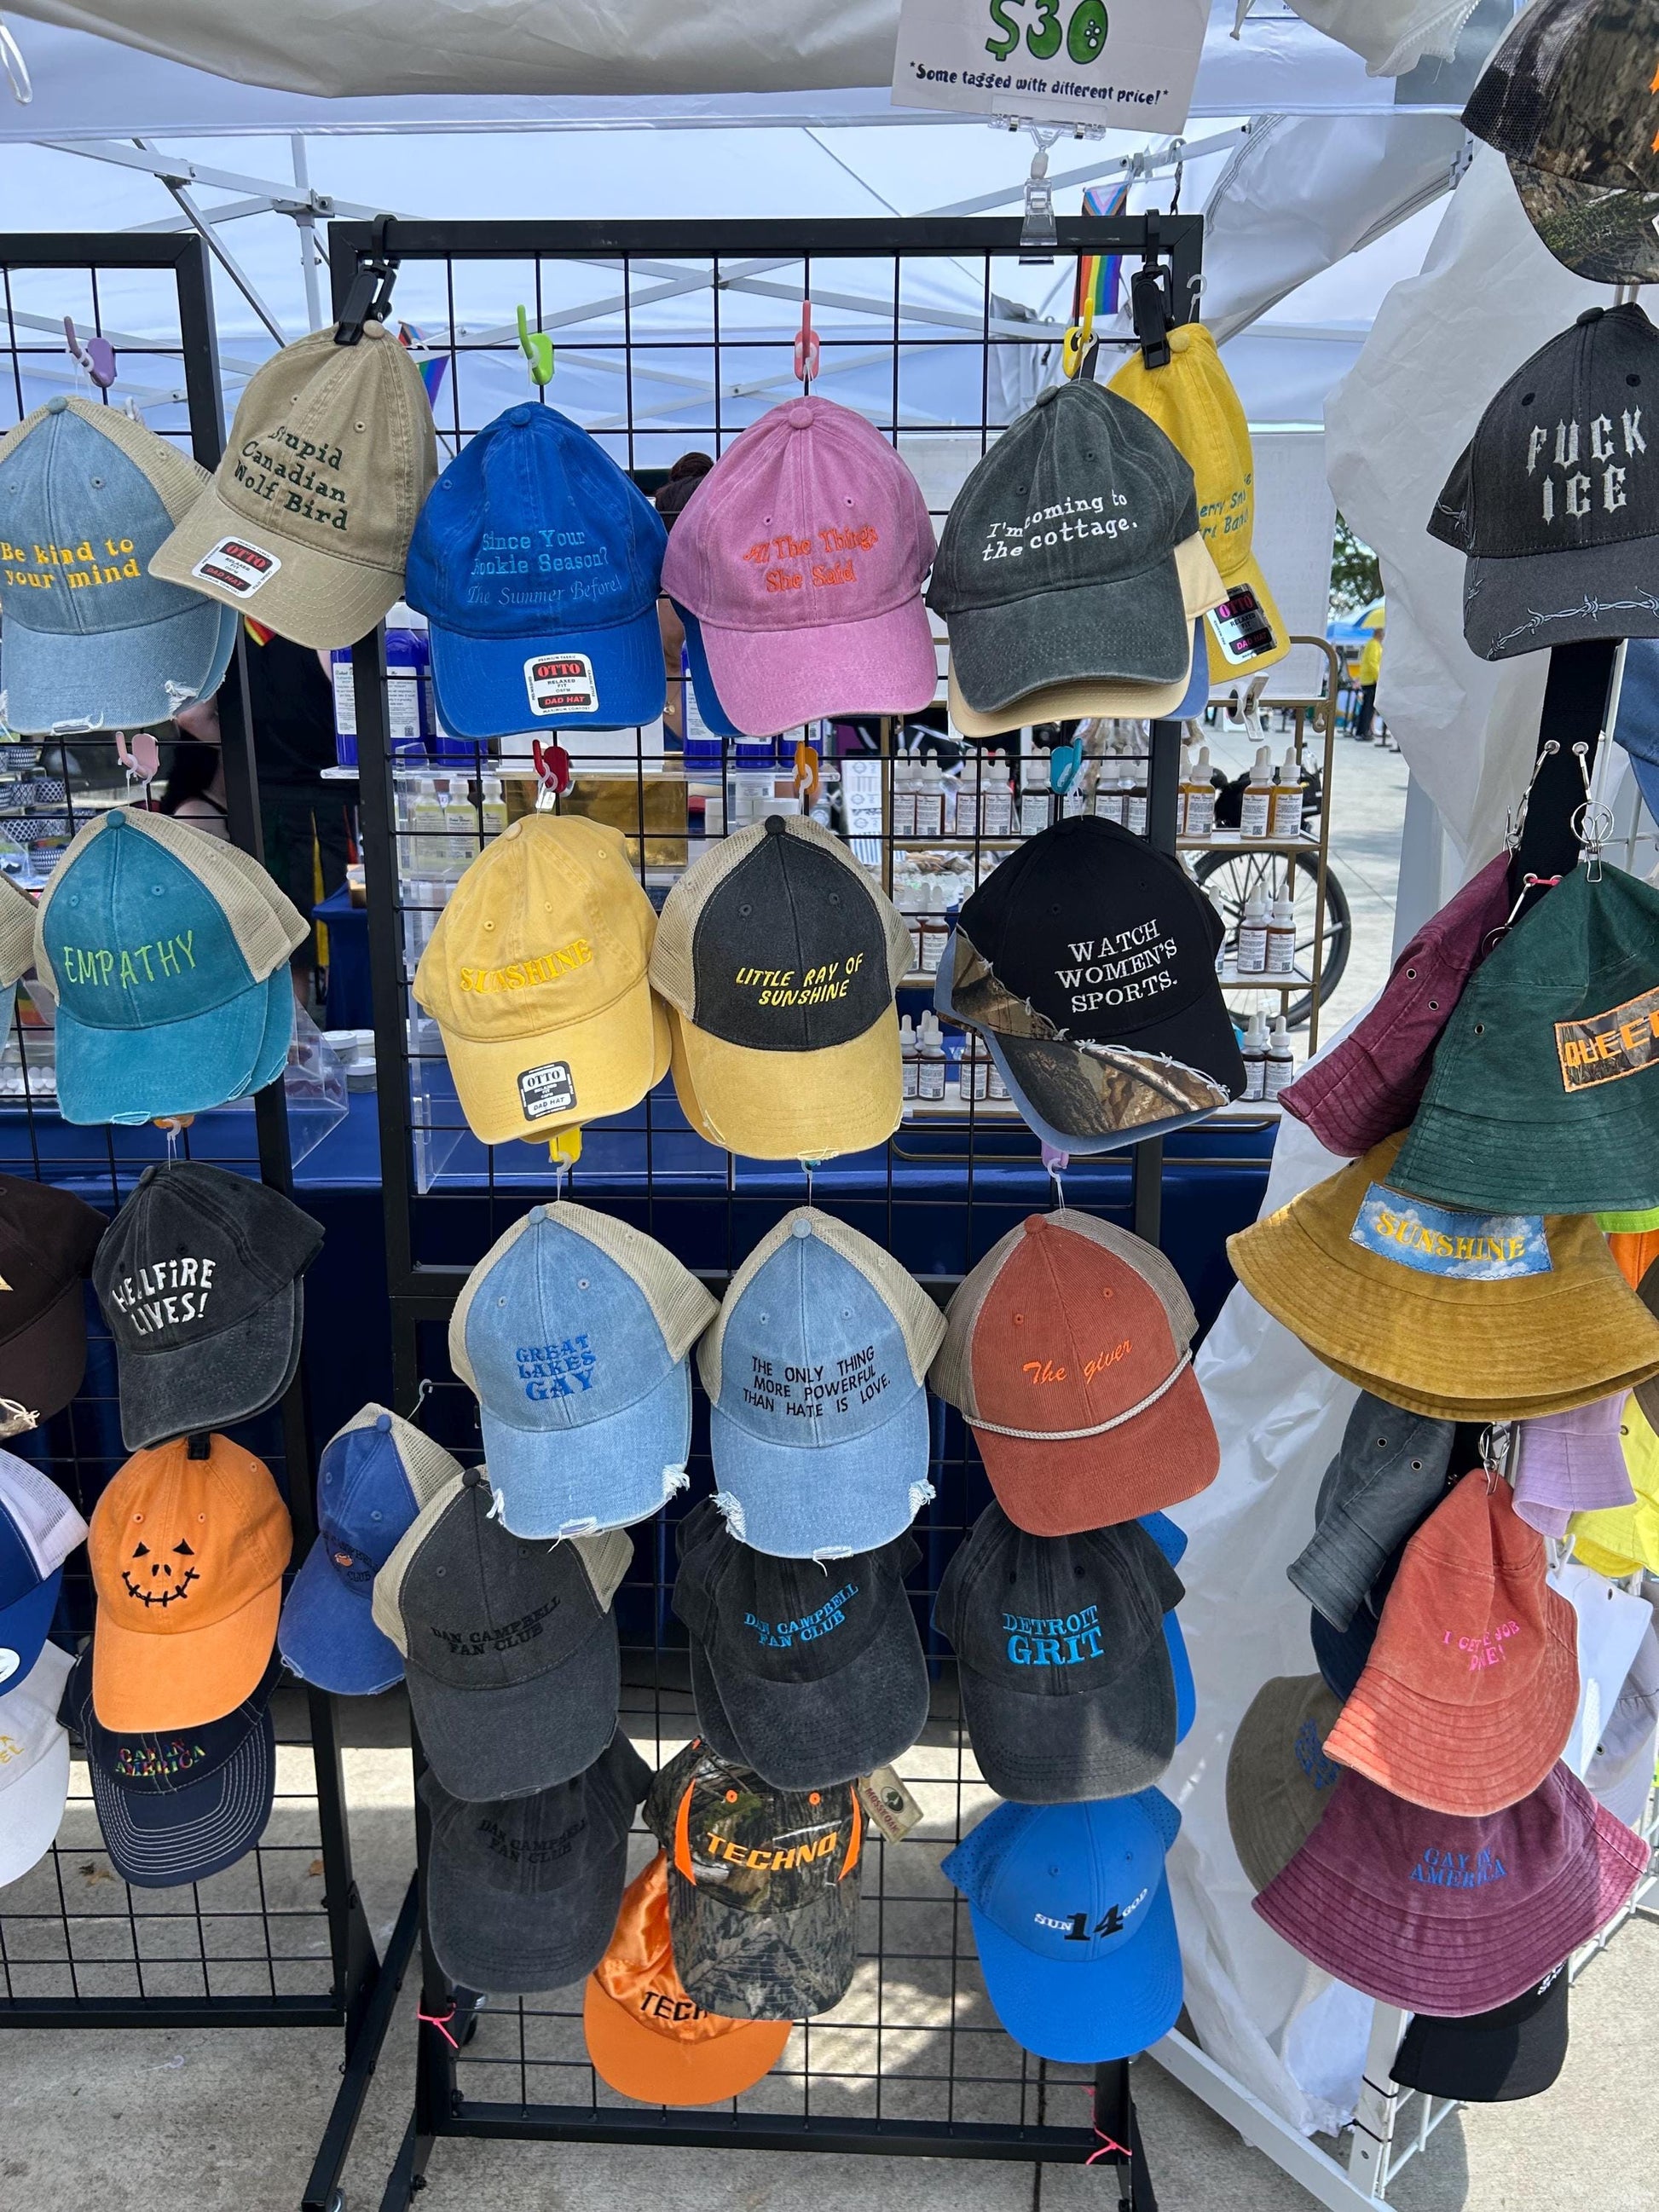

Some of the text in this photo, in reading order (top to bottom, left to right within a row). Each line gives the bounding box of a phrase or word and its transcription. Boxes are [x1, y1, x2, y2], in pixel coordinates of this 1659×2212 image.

[986, 0, 1108, 65] $30
[962, 69, 1011, 90] tagged
[1015, 77, 1047, 93] with
[1051, 80, 1113, 101] different
[268, 425, 343, 471] Stupid
[1526, 404, 1647, 477] FUCK
[242, 441, 347, 503] Canadian
[234, 459, 348, 531] Wolf Bird
[1542, 464, 1627, 526] ICE
[986, 488, 1127, 539] I'm coming to
[1, 538, 135, 565] Be kind to
[226, 545, 266, 568] OTTO
[483, 528, 586, 551] Since Your
[772, 535, 812, 559] The
[818, 524, 879, 552] Things
[982, 517, 1137, 561] the cottage.
[5, 558, 142, 589] your mind
[206, 567, 244, 586] DAD HAT
[539, 546, 609, 572] Season?
[766, 559, 857, 592] She Said
[466, 574, 622, 607] The Summer Before!
[1219, 595, 1253, 618] OTTO
[1230, 613, 1256, 627] RELAXED
[1236, 638, 1252, 650] DAD
[537, 663, 581, 678] OTTO
[545, 697, 564, 706] DAD
[1067, 919, 1160, 962] WATCH
[63, 930, 196, 989] EMPATHY
[736, 952, 864, 987] LITTLE RAY OF
[1055, 938, 1177, 989] WOMEN'S
[758, 979, 849, 1007] SUNSHINE
[1071, 969, 1177, 1013] SPORTS.
[527, 1070, 561, 1087] OTTO
[534, 1101, 547, 1110] DAD
[1376, 1212, 1525, 1262] SUNSHINE
[131, 1292, 208, 1336] LIVES!
[516, 1333, 590, 1363] GREAT
[517, 1349, 596, 1378] LAKES
[752, 1345, 875, 1383] THE ONLY THING
[1023, 1338, 1132, 1384] The giver
[525, 1366, 594, 1401] GAY
[743, 1373, 891, 1418] THAN HATE IS LOVE.
[754, 1364, 876, 1401] MORE POWERFUL
[431, 1596, 561, 1643] DAN CAMPBELL
[743, 1582, 858, 1635] DAN CAMPBELL
[1003, 1604, 1099, 1636] DETROIT
[448, 1621, 544, 1655] FAN CLUB
[759, 1609, 846, 1648] FAN CLUB
[1007, 1626, 1104, 1666] GRIT
[1442, 1629, 1453, 1645] I
[1458, 1636, 1482, 1652] GET
[1494, 1620, 1520, 1641] JOB
[865, 1787, 899, 1834] MOSSY OAK
[707, 1831, 837, 1871] TECHNO
[1423, 1846, 1470, 1868] GAY
[1034, 1913, 1074, 1931] SUN
[1064, 1903, 1124, 1941] 14
